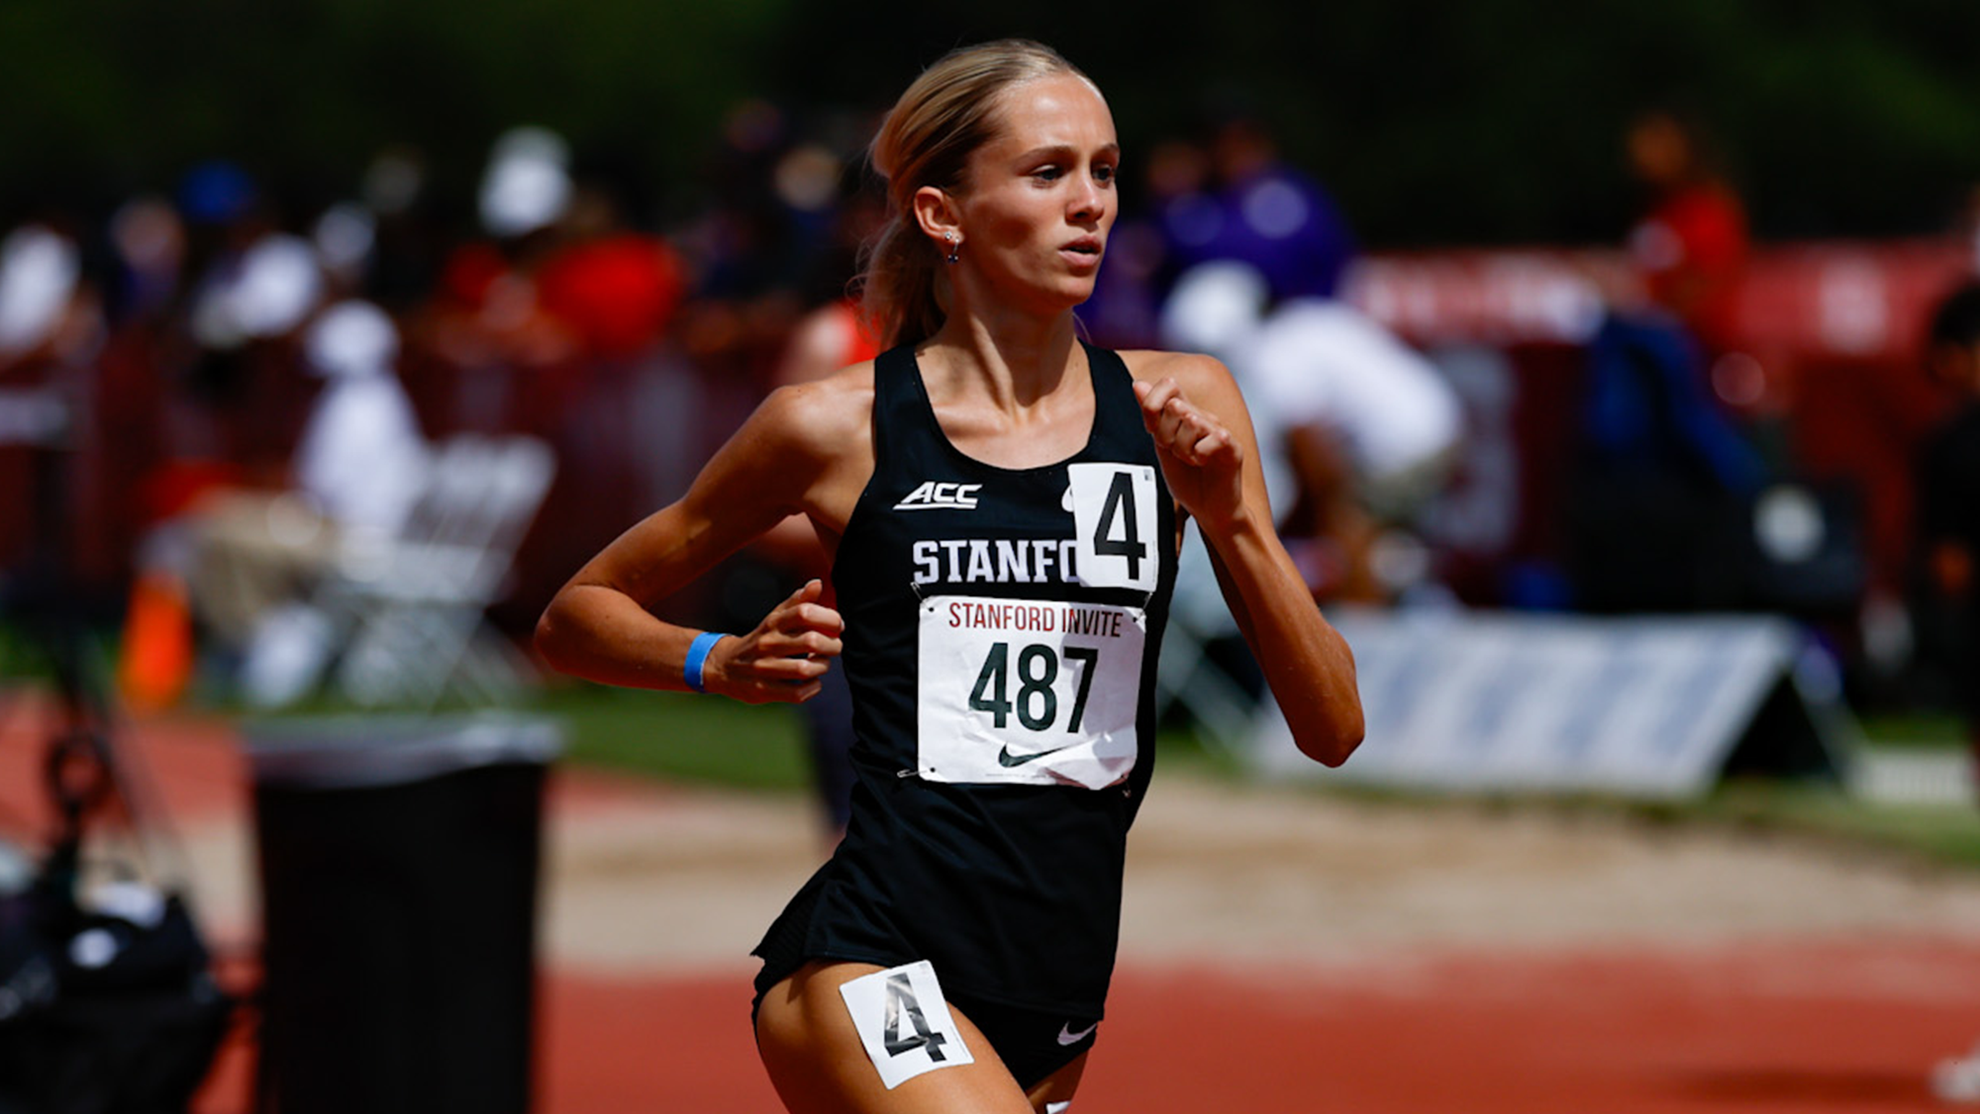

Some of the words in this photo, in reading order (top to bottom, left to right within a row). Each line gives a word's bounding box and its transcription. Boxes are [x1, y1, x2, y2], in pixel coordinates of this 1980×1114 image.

[893, 481, 983, 510] ACC
[1093, 471, 1146, 580] 4
[949, 602, 1055, 632] STANFORD
[1062, 608, 1124, 638] INVITE
[968, 642, 1099, 734] 487
[884, 972, 947, 1062] 4
